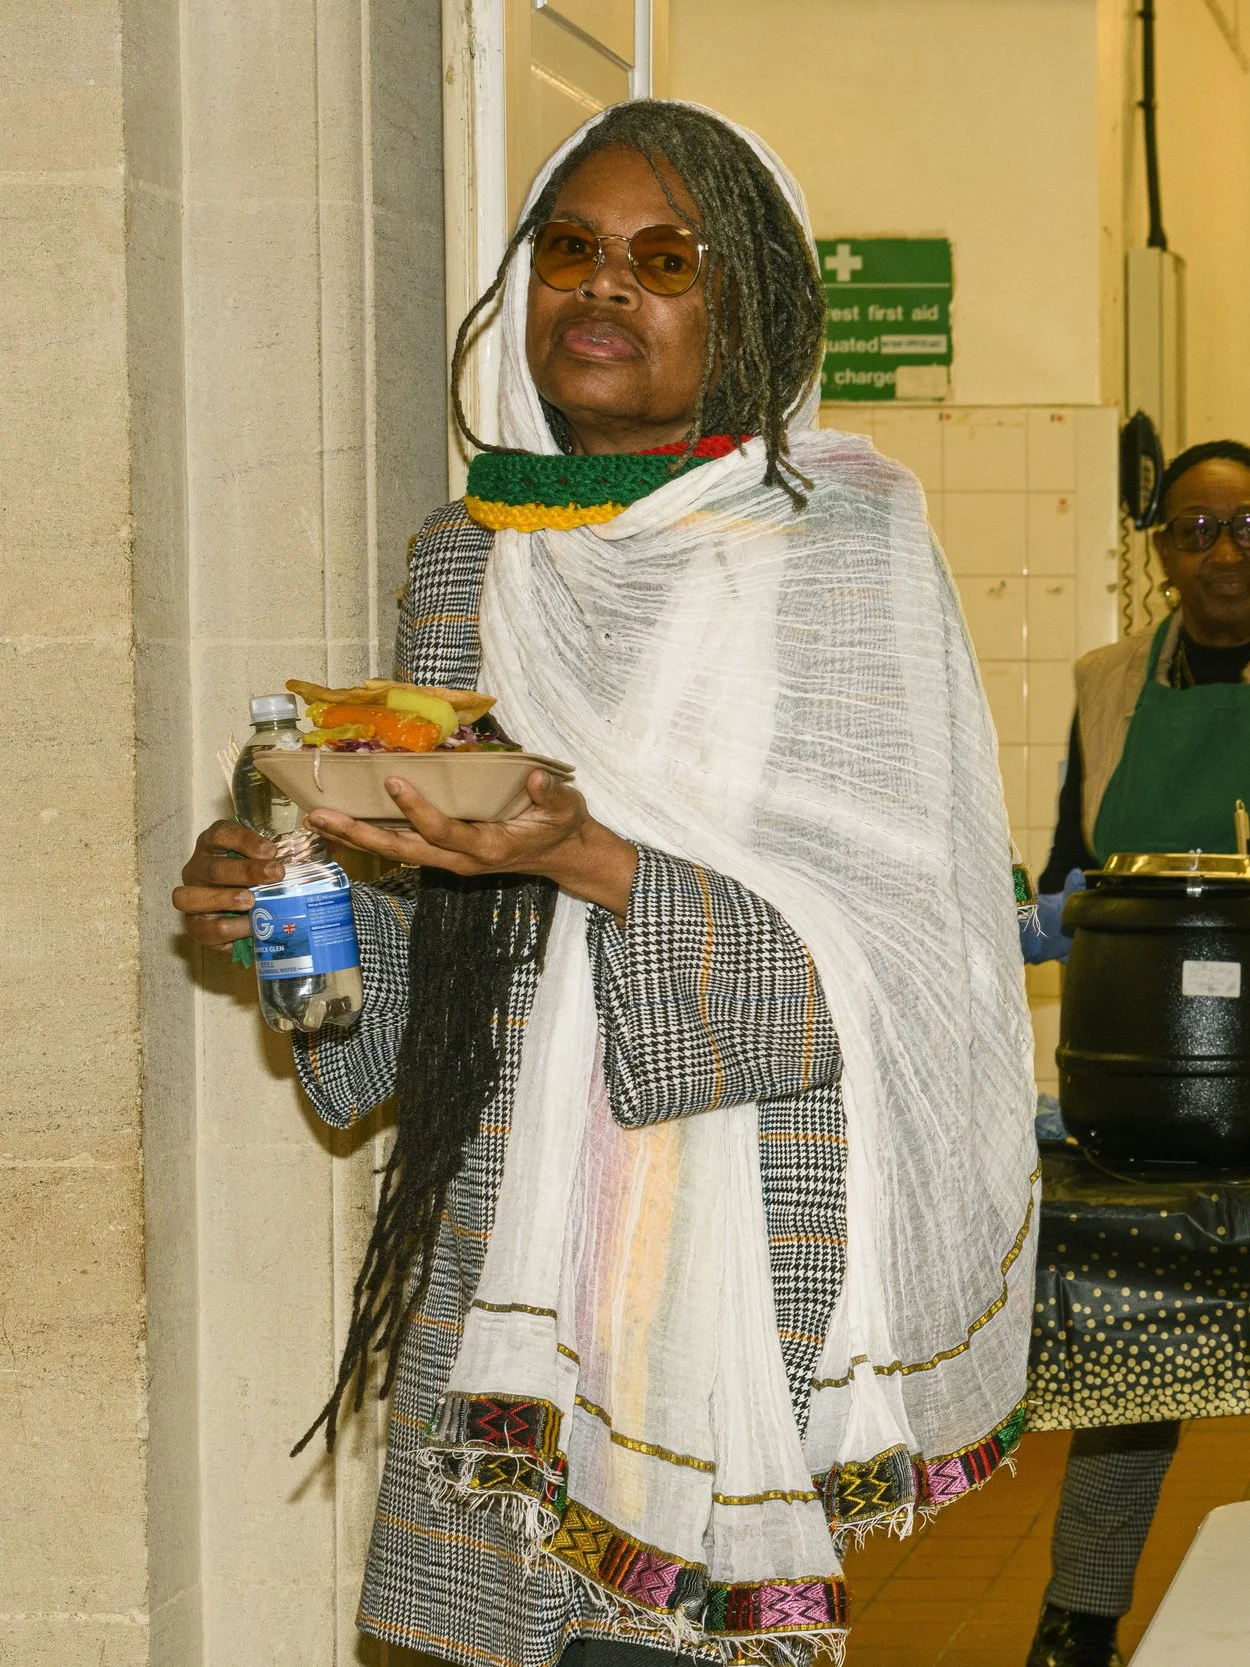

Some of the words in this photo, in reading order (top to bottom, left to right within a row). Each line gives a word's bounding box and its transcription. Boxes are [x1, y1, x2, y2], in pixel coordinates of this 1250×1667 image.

[867, 304, 904, 321] first
[911, 304, 939, 321] aid
[827, 338, 879, 353] uated
